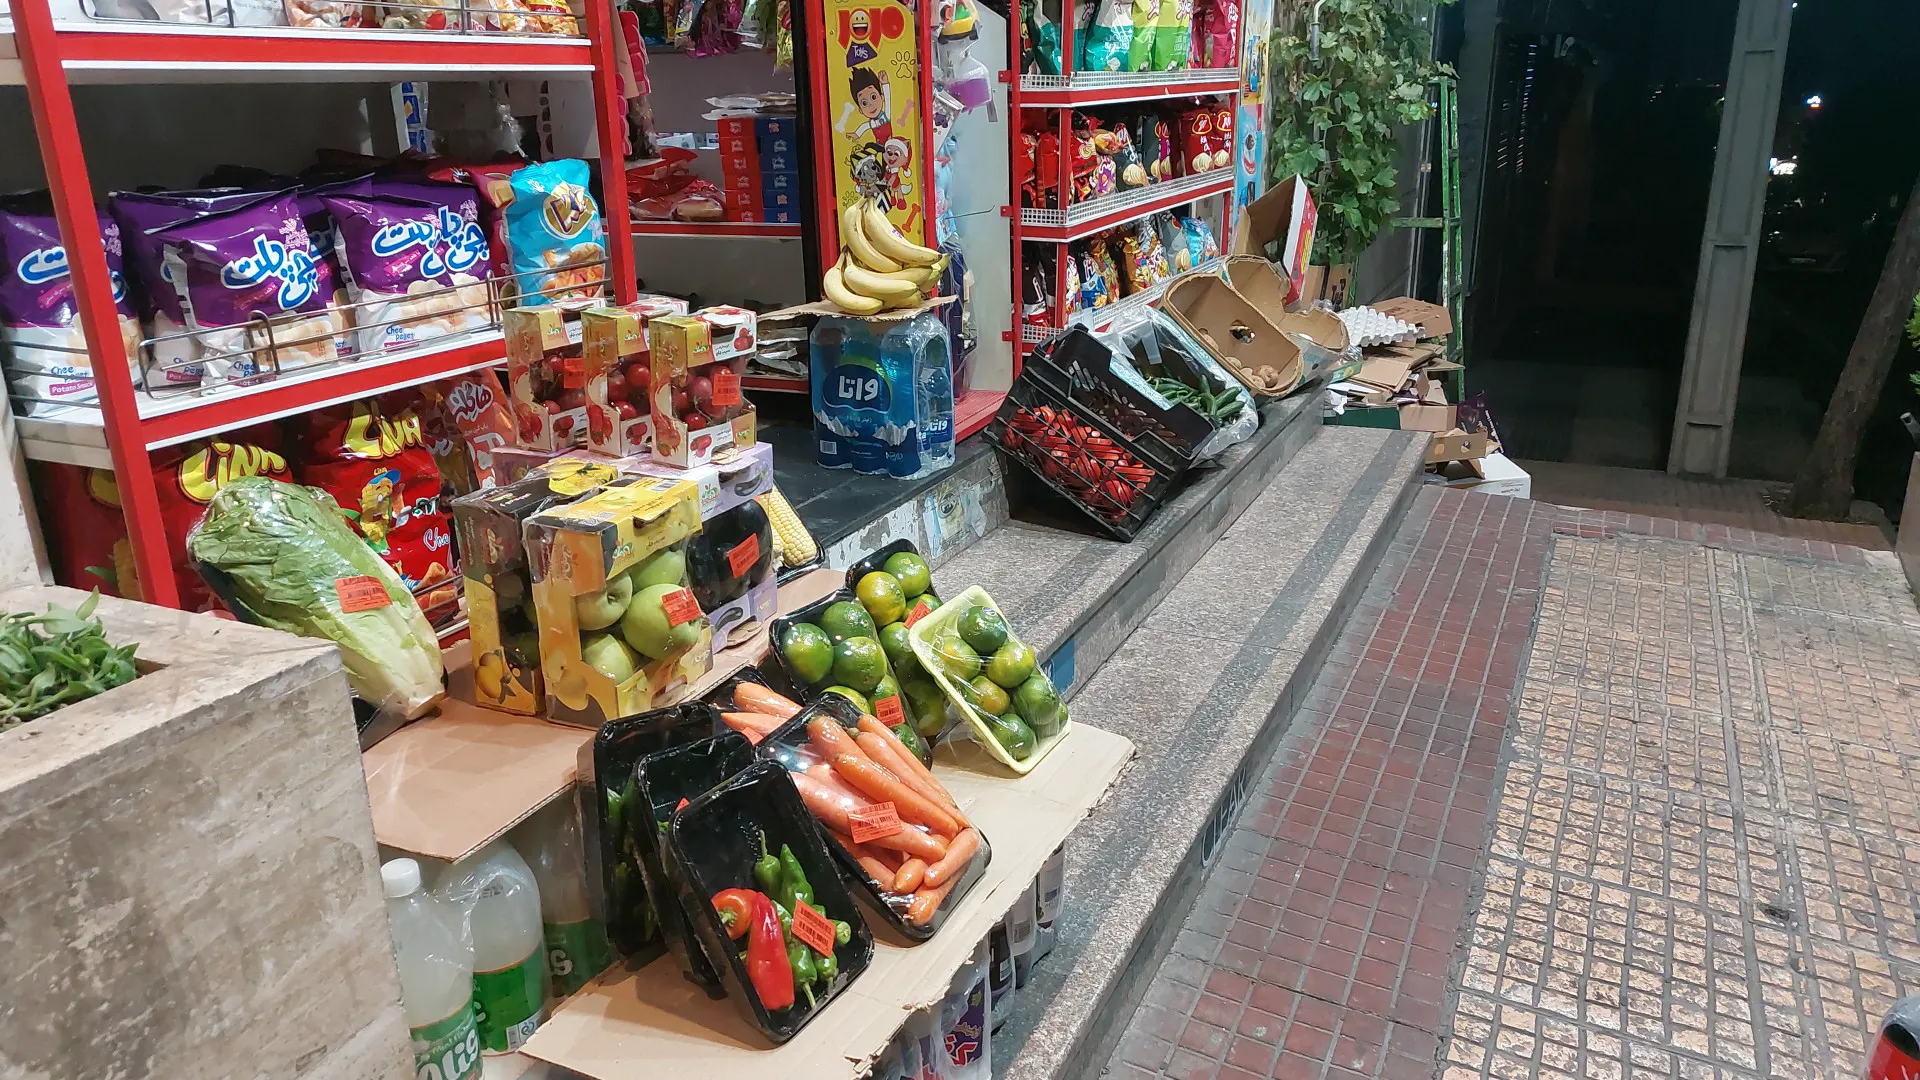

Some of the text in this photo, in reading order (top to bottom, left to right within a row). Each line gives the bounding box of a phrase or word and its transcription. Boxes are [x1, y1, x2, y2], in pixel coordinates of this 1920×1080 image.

[222, 236, 319, 309] چی پلت
[52, 383, 76, 392] Potato
[838, 375, 879, 401] واتا
